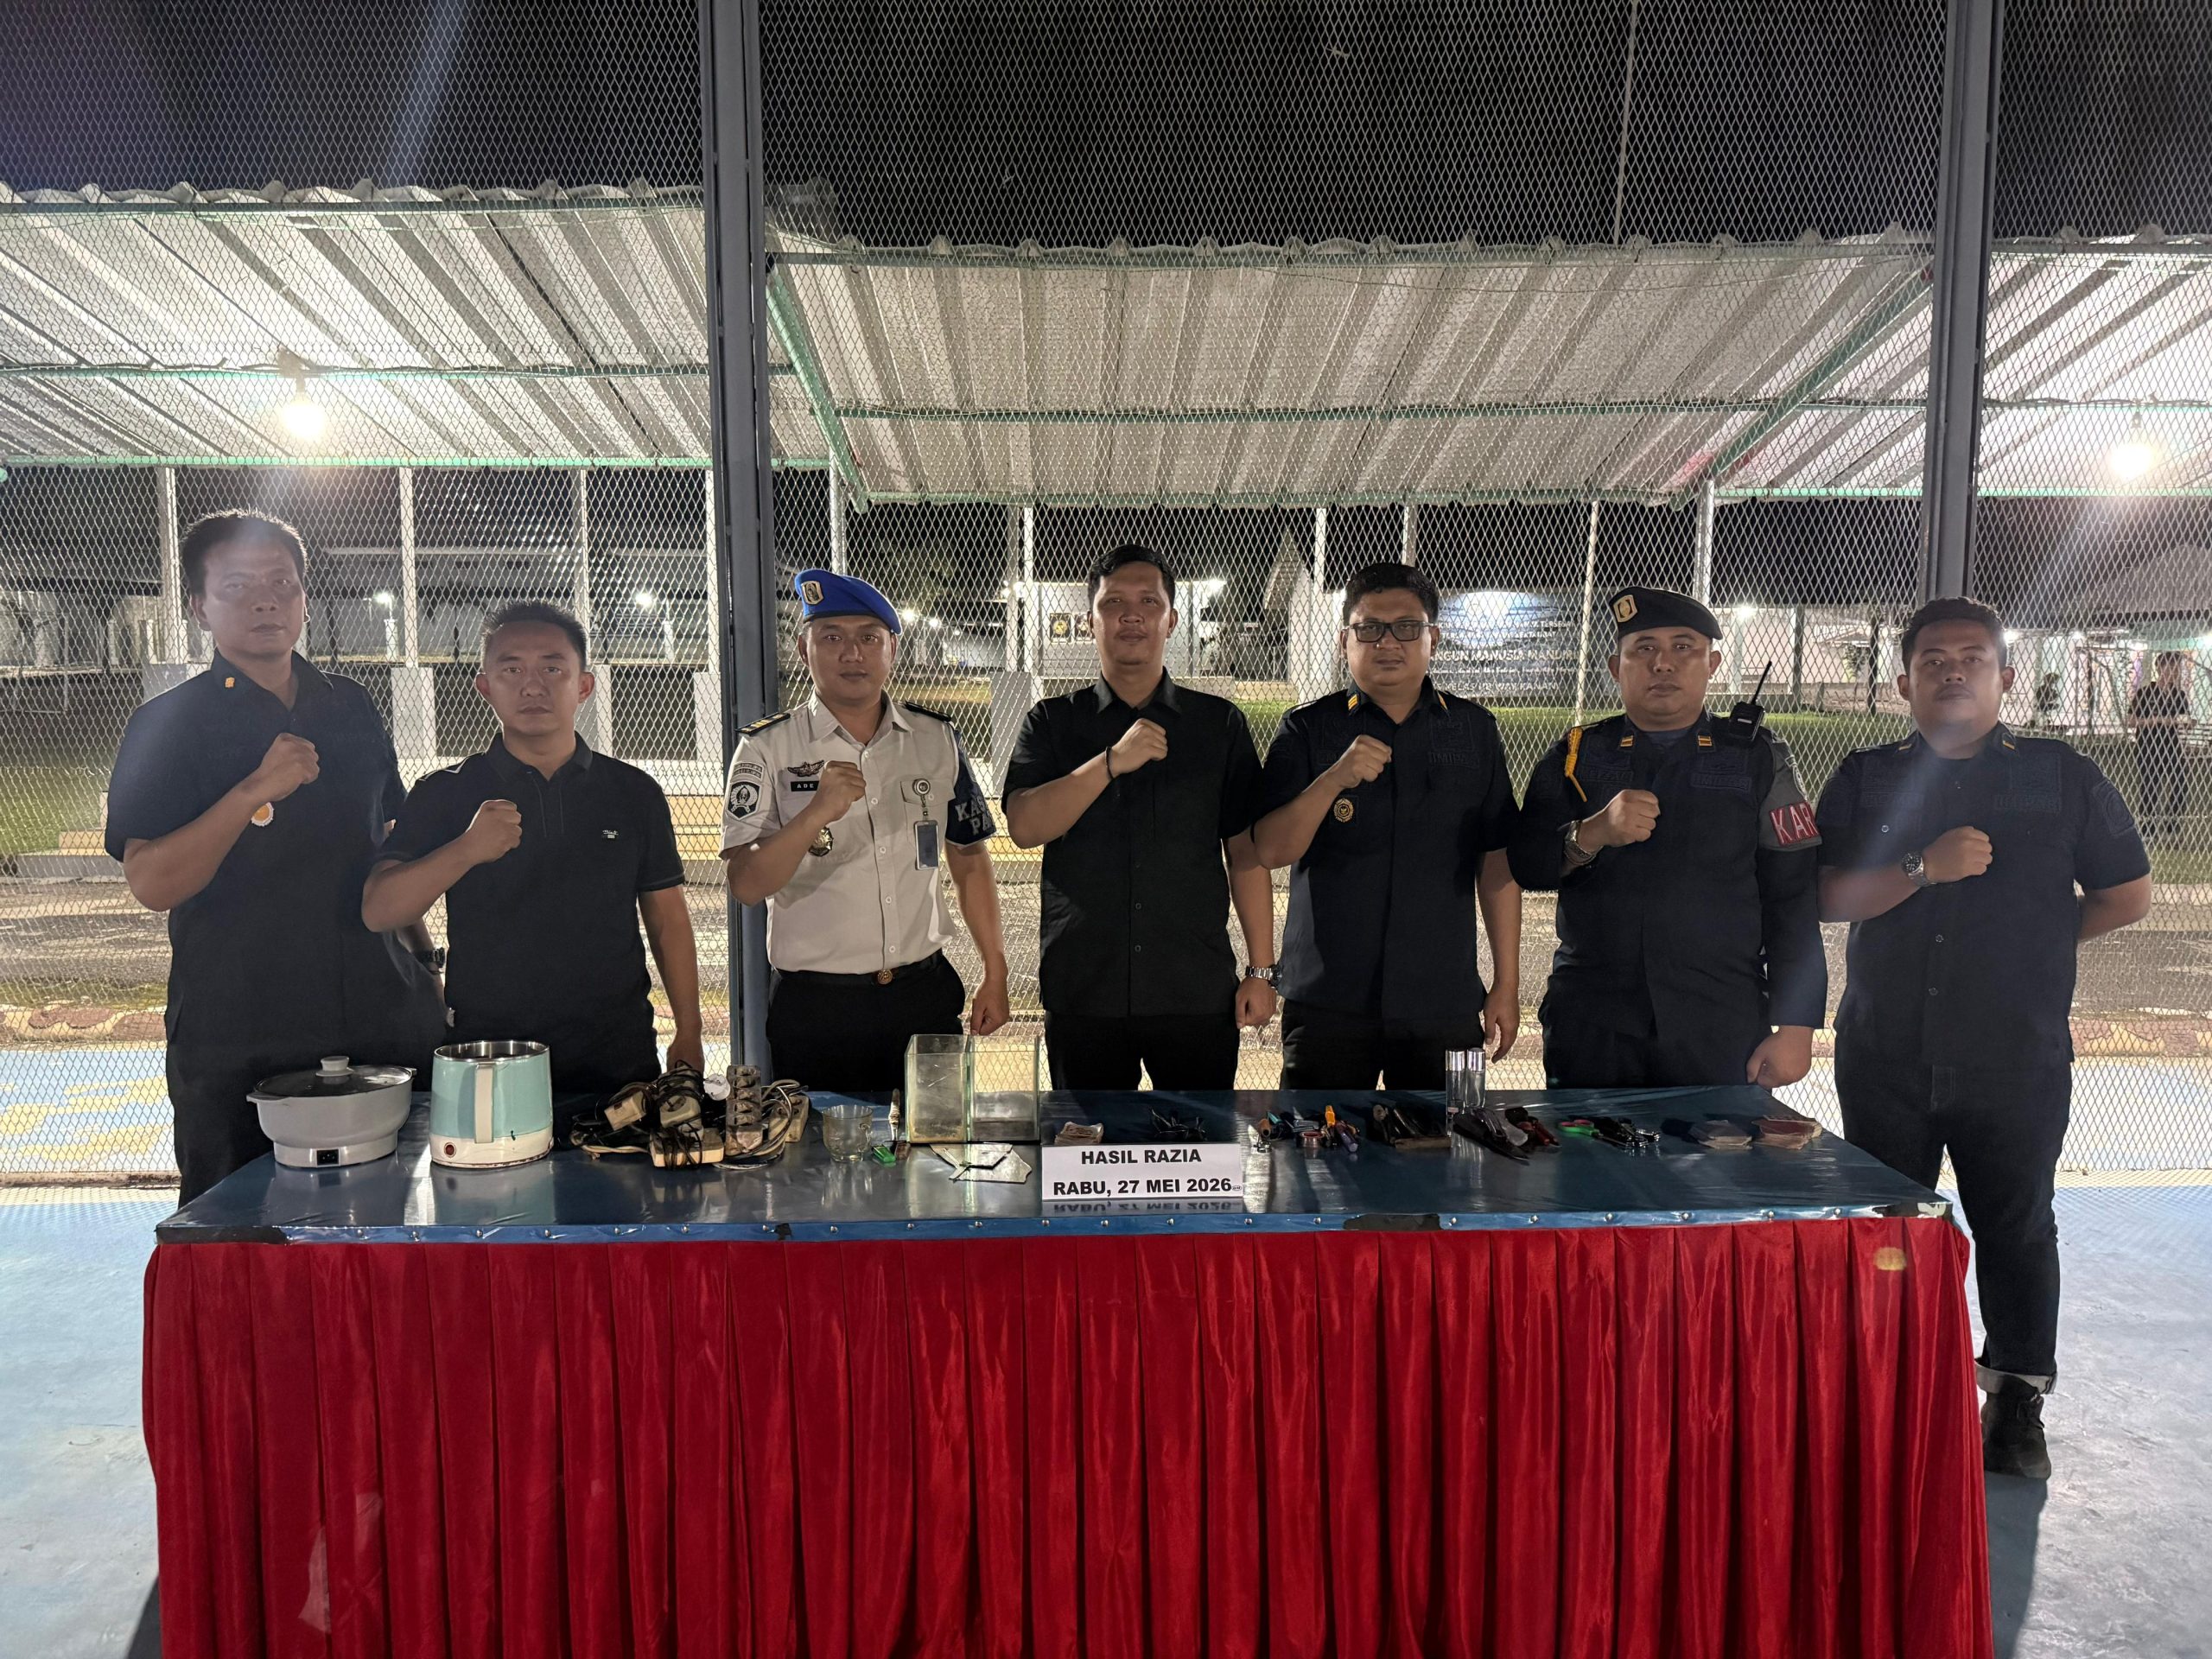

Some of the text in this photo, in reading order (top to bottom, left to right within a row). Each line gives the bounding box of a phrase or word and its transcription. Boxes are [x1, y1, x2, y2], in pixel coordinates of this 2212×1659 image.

[1770, 803, 1821, 845] KAR
[1081, 1148, 1202, 1165] HASIL RAZIA
[1053, 1181, 1112, 1197] RABU,
[1117, 1179, 1140, 1194] 27
[1147, 1179, 1180, 1193] MEI
[1186, 1178, 1232, 1192] 2026
